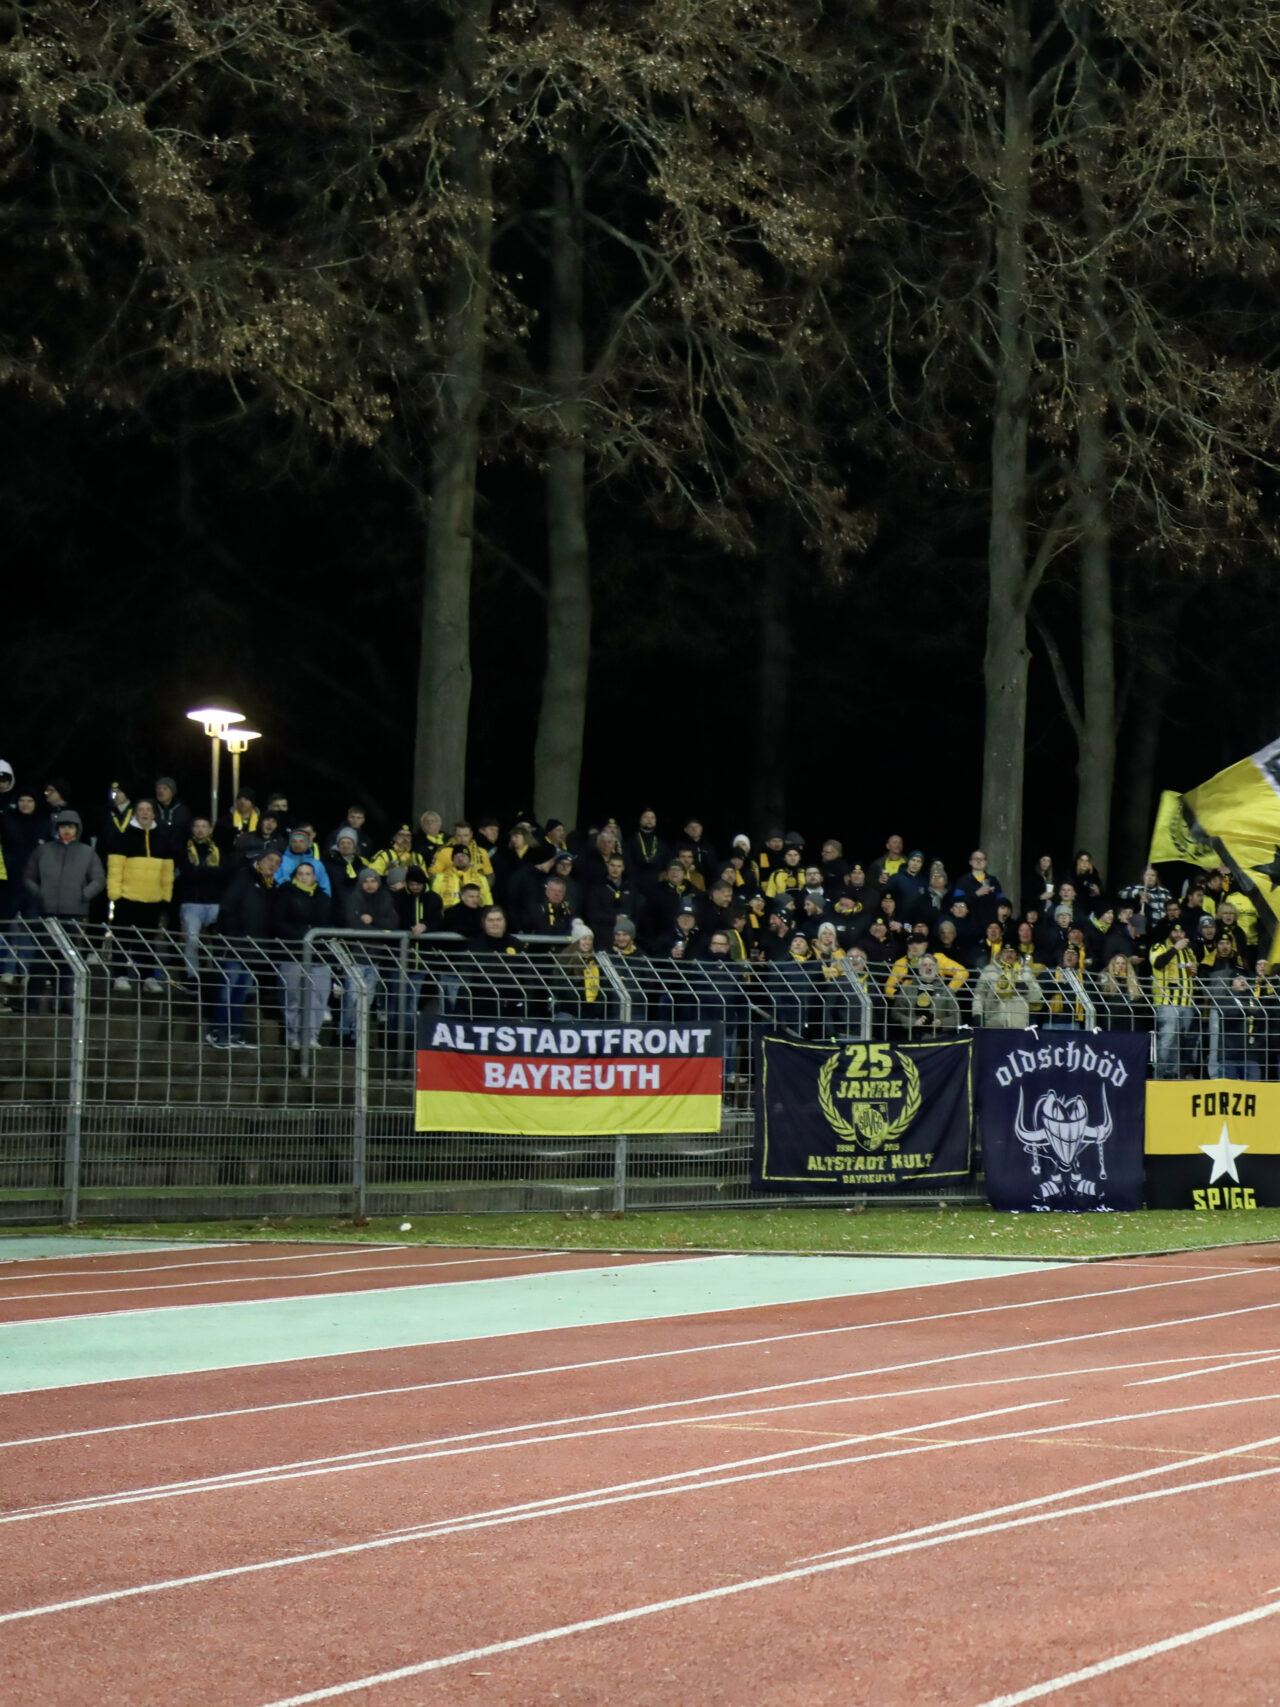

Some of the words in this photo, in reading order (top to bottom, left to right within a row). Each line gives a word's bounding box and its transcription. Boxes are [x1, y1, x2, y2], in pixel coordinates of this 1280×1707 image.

[432, 1022, 711, 1054] ALTSTADTFRONT
[845, 1043, 893, 1078] 25
[484, 1062, 660, 1090] BAYREUTH
[836, 1080, 903, 1099] JAHRE
[1192, 1091, 1256, 1117] FORZA
[807, 1155, 888, 1171] ALTSTADT
[891, 1153, 934, 1169] KULT
[842, 1173, 897, 1184] BAYREUTH
